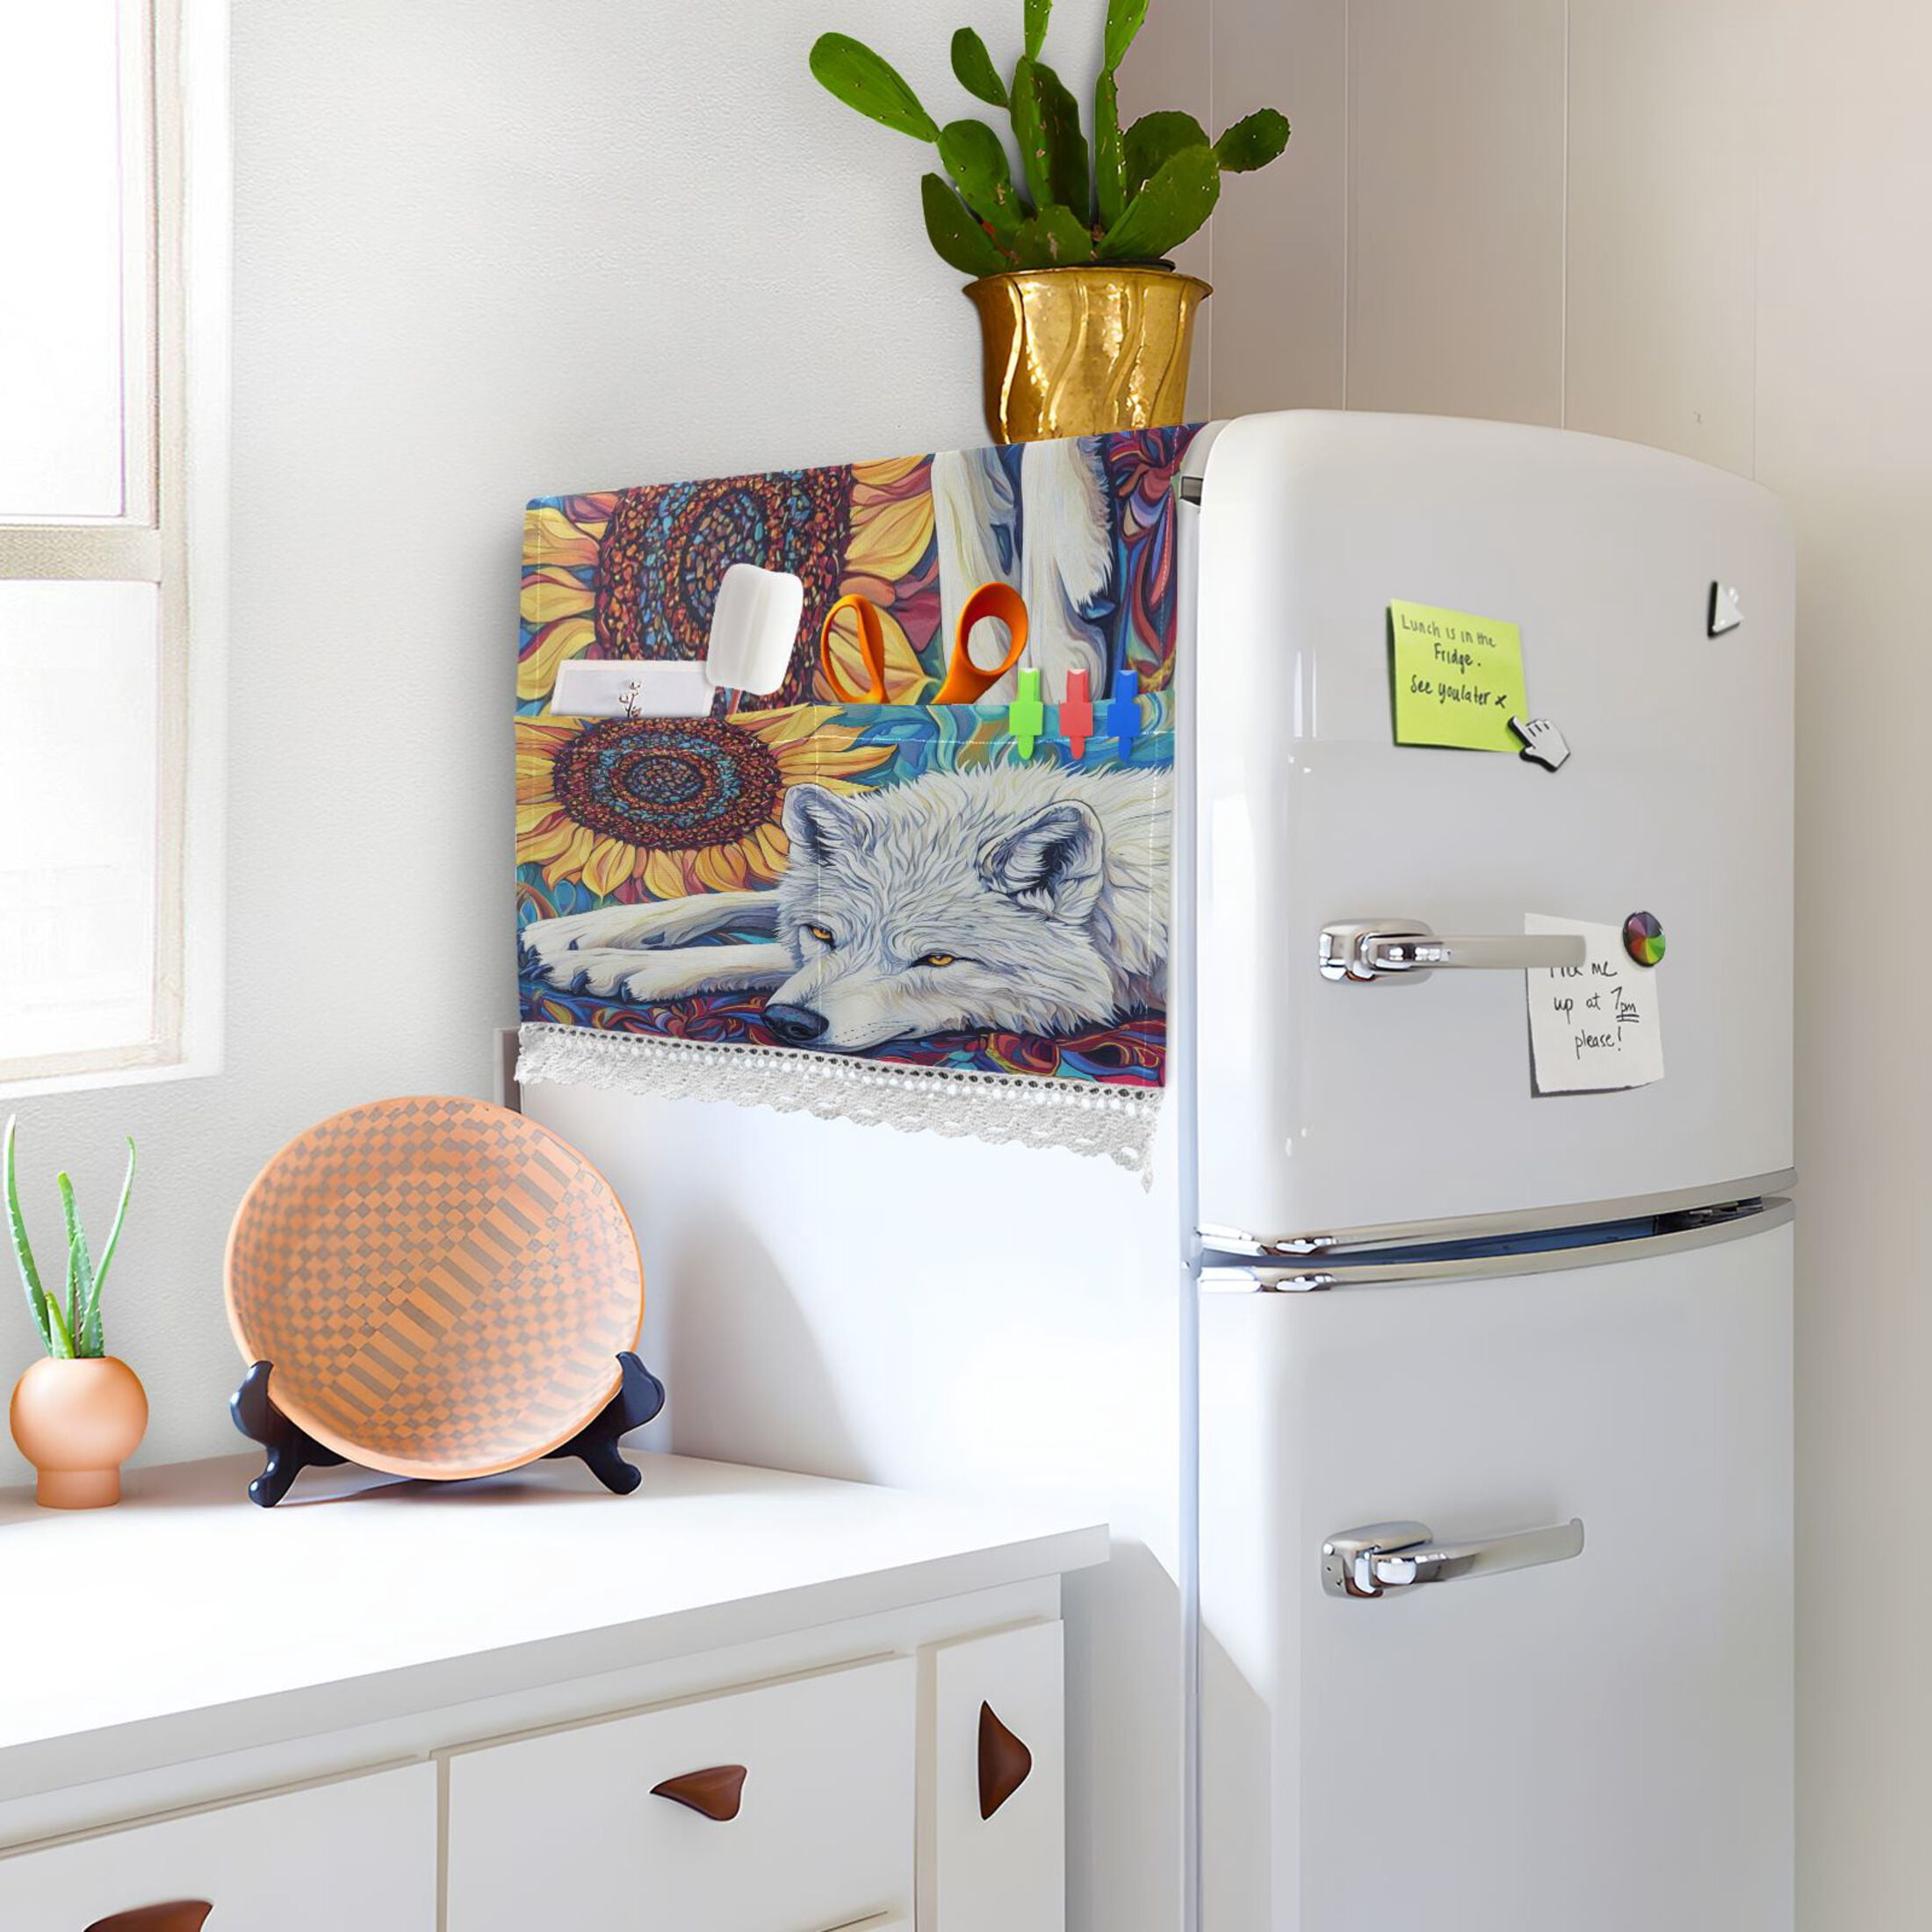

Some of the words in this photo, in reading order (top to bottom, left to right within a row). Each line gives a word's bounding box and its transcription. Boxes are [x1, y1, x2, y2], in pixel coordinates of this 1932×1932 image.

[1402, 614, 1441, 638] Lunch
[1445, 627, 1456, 640] is
[1460, 630, 1474, 644] in
[1477, 631, 1496, 647] the
[1410, 674, 1433, 694] See
[1554, 997, 1574, 1024] up
[1586, 992, 1601, 1010] at
[1575, 1026, 1622, 1060] please!
